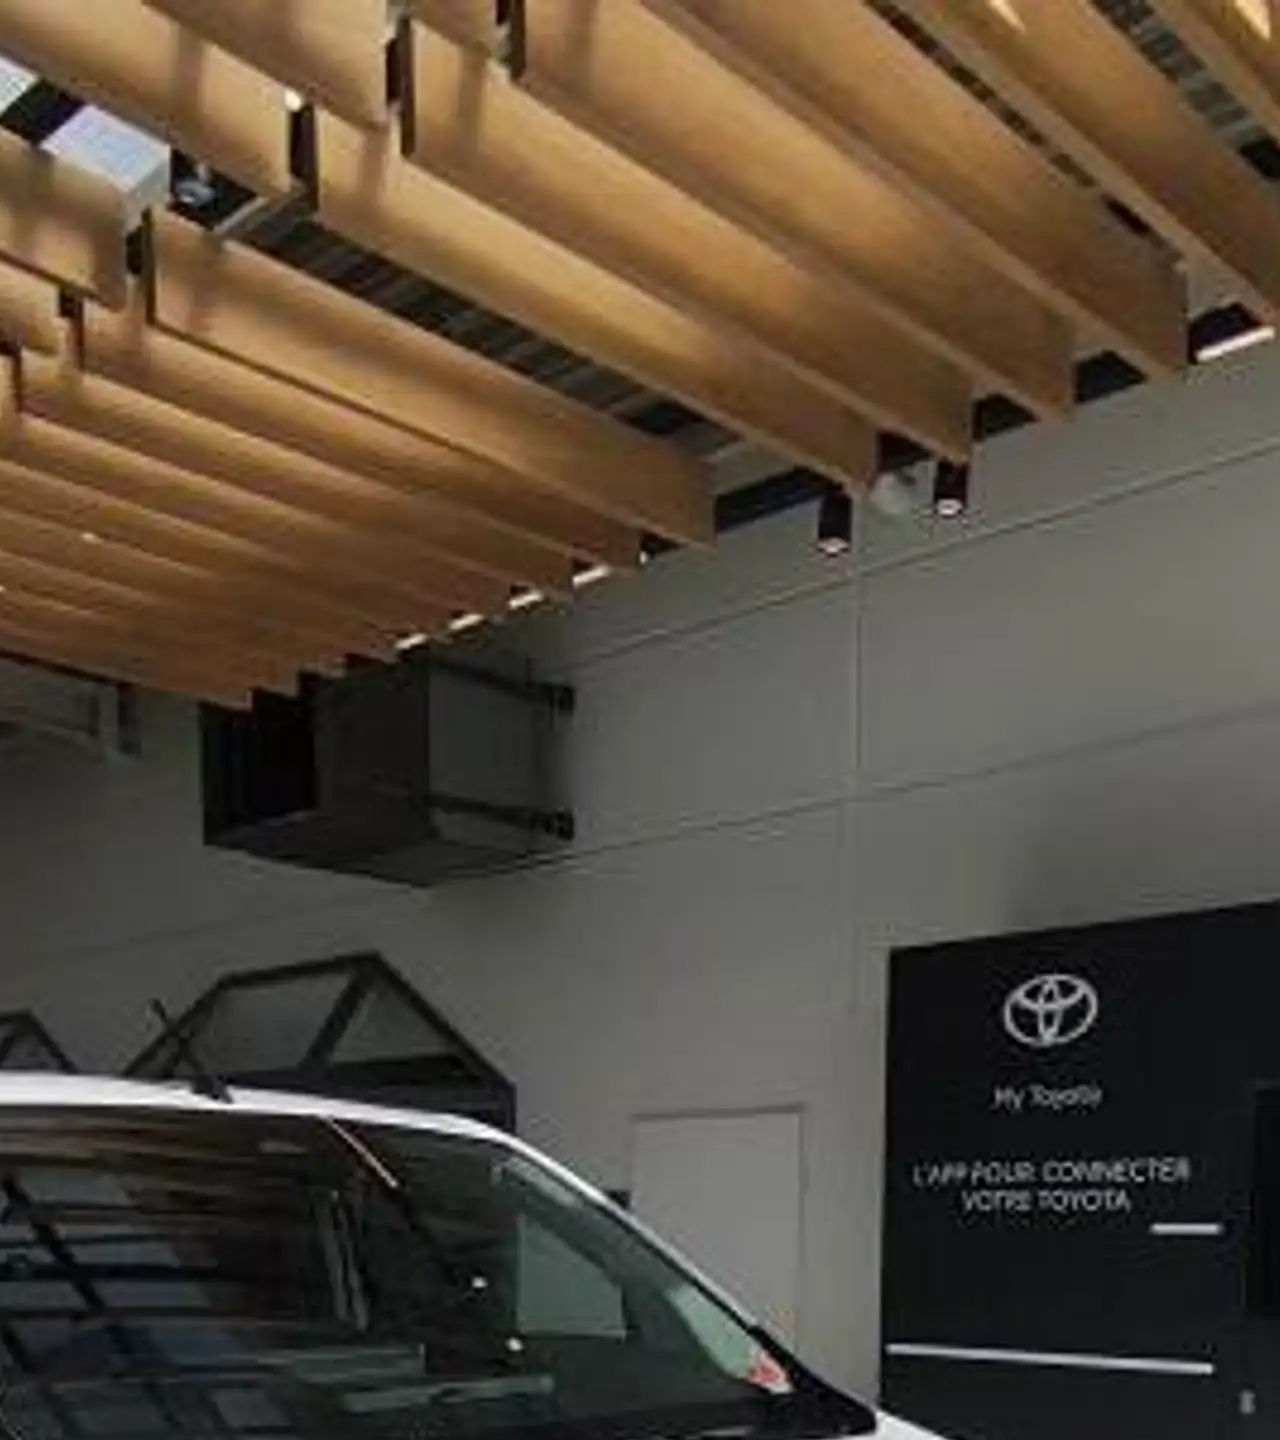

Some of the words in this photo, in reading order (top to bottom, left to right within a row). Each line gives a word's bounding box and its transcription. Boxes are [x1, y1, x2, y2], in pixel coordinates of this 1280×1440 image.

[993, 1086, 1023, 1110] My
[970, 1160, 1035, 1184] POUR
[1042, 1156, 1190, 1182] CONNECTER
[961, 1189, 1030, 1211] VOTRE
[1037, 1189, 1131, 1212] TOYOTA
